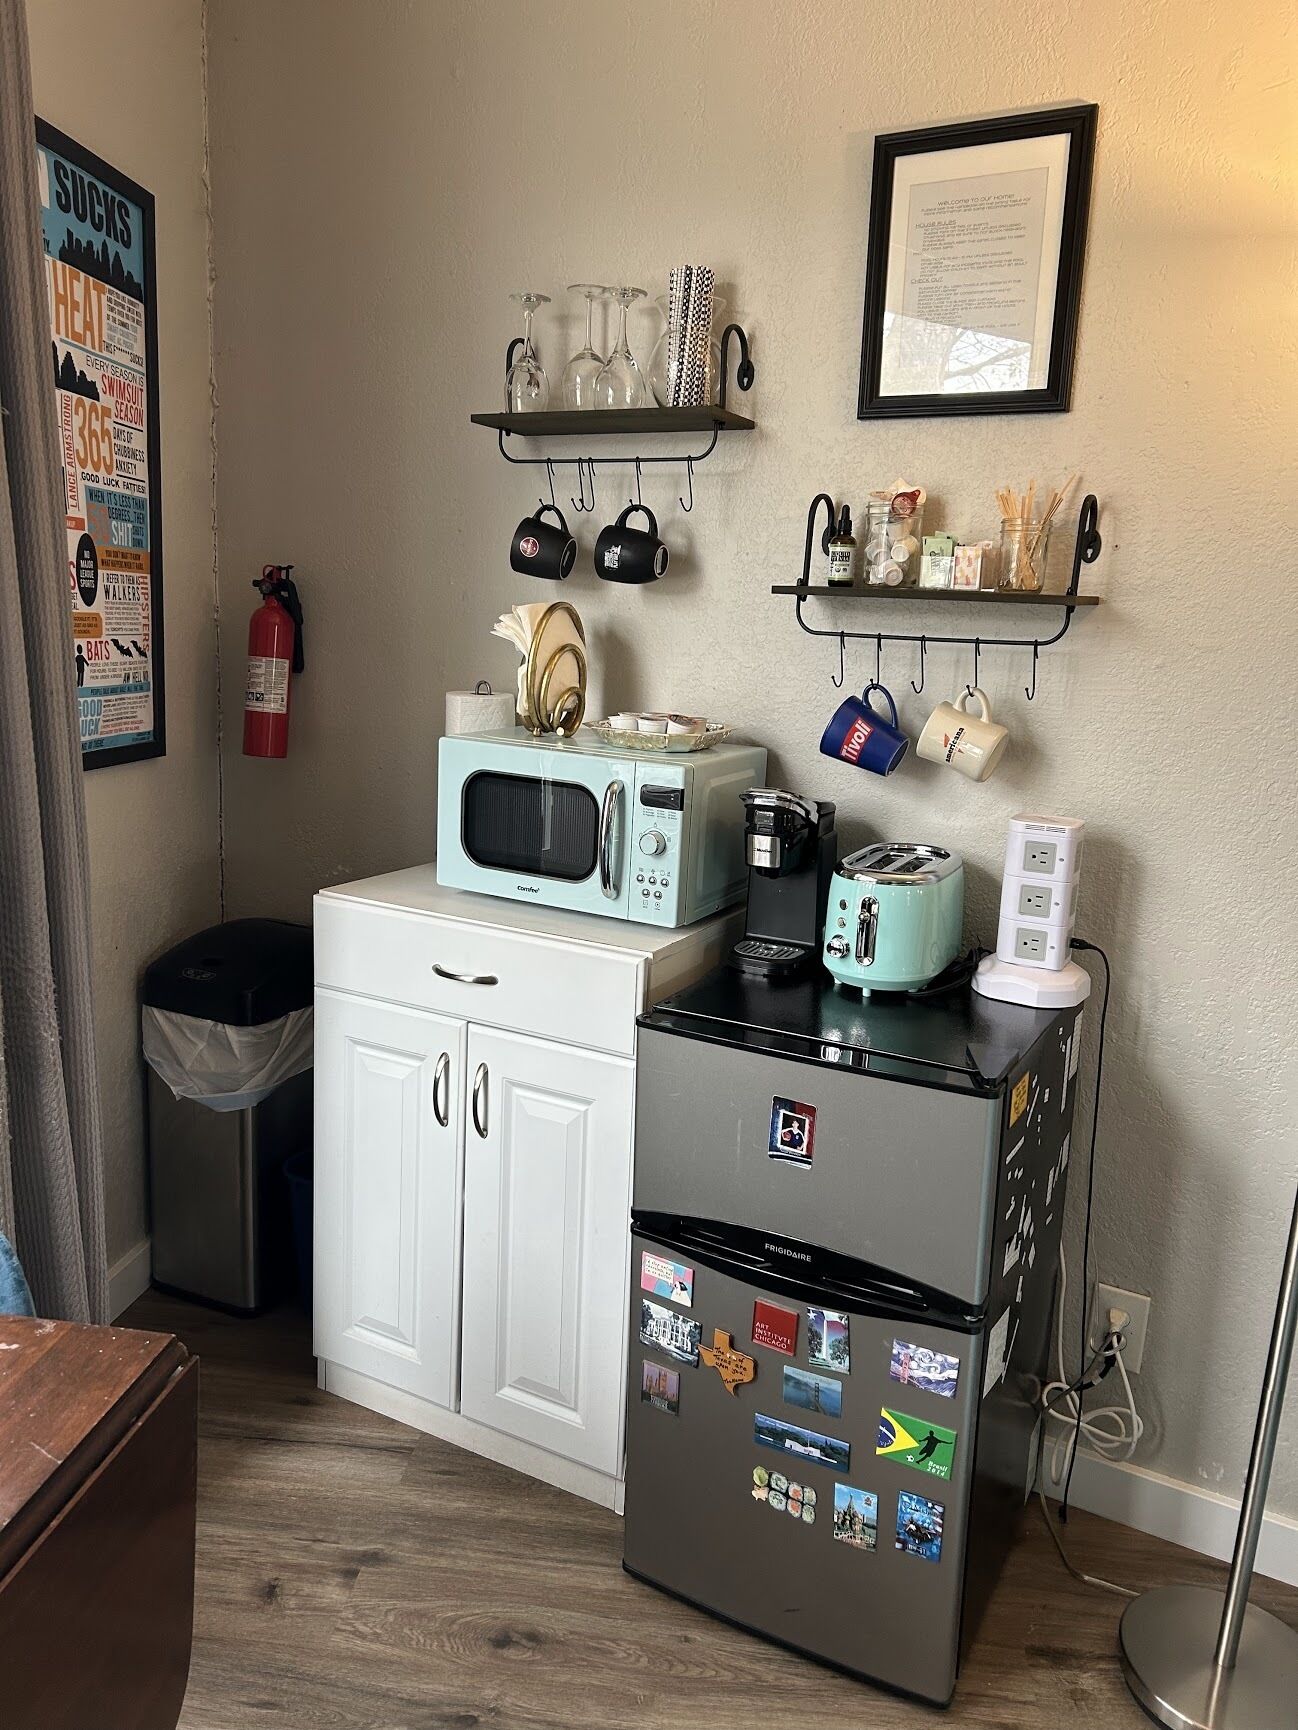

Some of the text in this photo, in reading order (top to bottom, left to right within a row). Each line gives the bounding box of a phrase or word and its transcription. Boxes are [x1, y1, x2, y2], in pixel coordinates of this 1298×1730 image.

[54, 160, 131, 249] SUCKS
[52, 260, 106, 353] HEAT
[86, 355, 144, 387] EVERY SEASON IS
[102, 374, 144, 408] SWIMSUIT
[115, 400, 144, 427] SEASON
[63, 394, 75, 468] ARMSTRONG
[74, 397, 114, 475] 365
[113, 427, 133, 444] DAYS OF
[114, 443, 144, 462] CHUBBINESS
[82, 471, 99, 483] GOOD
[102, 476, 120, 488] LUCK
[68, 471, 77, 508] LANCE
[88, 488, 104, 503] WHEN
[120, 493, 131, 508] LESS
[132, 496, 144, 511] THAN
[112, 521, 132, 547] SHIT
[80, 560, 94, 569] MAJOR
[80, 569, 94, 578] LEAGUE
[80, 579, 95, 588] SPORTS
[107, 573, 119, 583] REFER
[120, 575, 124, 584] TO
[104, 584, 140, 601] WALKERS
[140, 576, 149, 653] HIPSTERS
[86, 641, 110, 660] BATS
[81, 718, 100, 737] UCK
[841, 720, 871, 760] Tivoli
[765, 1243, 811, 1262] FRIGIDAIRE
[756, 1322, 769, 1330] ART
[715, 1347, 724, 1355] The
[755, 1334, 787, 1349] CHICAGO
[713, 1354, 747, 1371] Texas are
[716, 1361, 728, 1370] upon
[928, 1461, 948, 1472] Brasil
